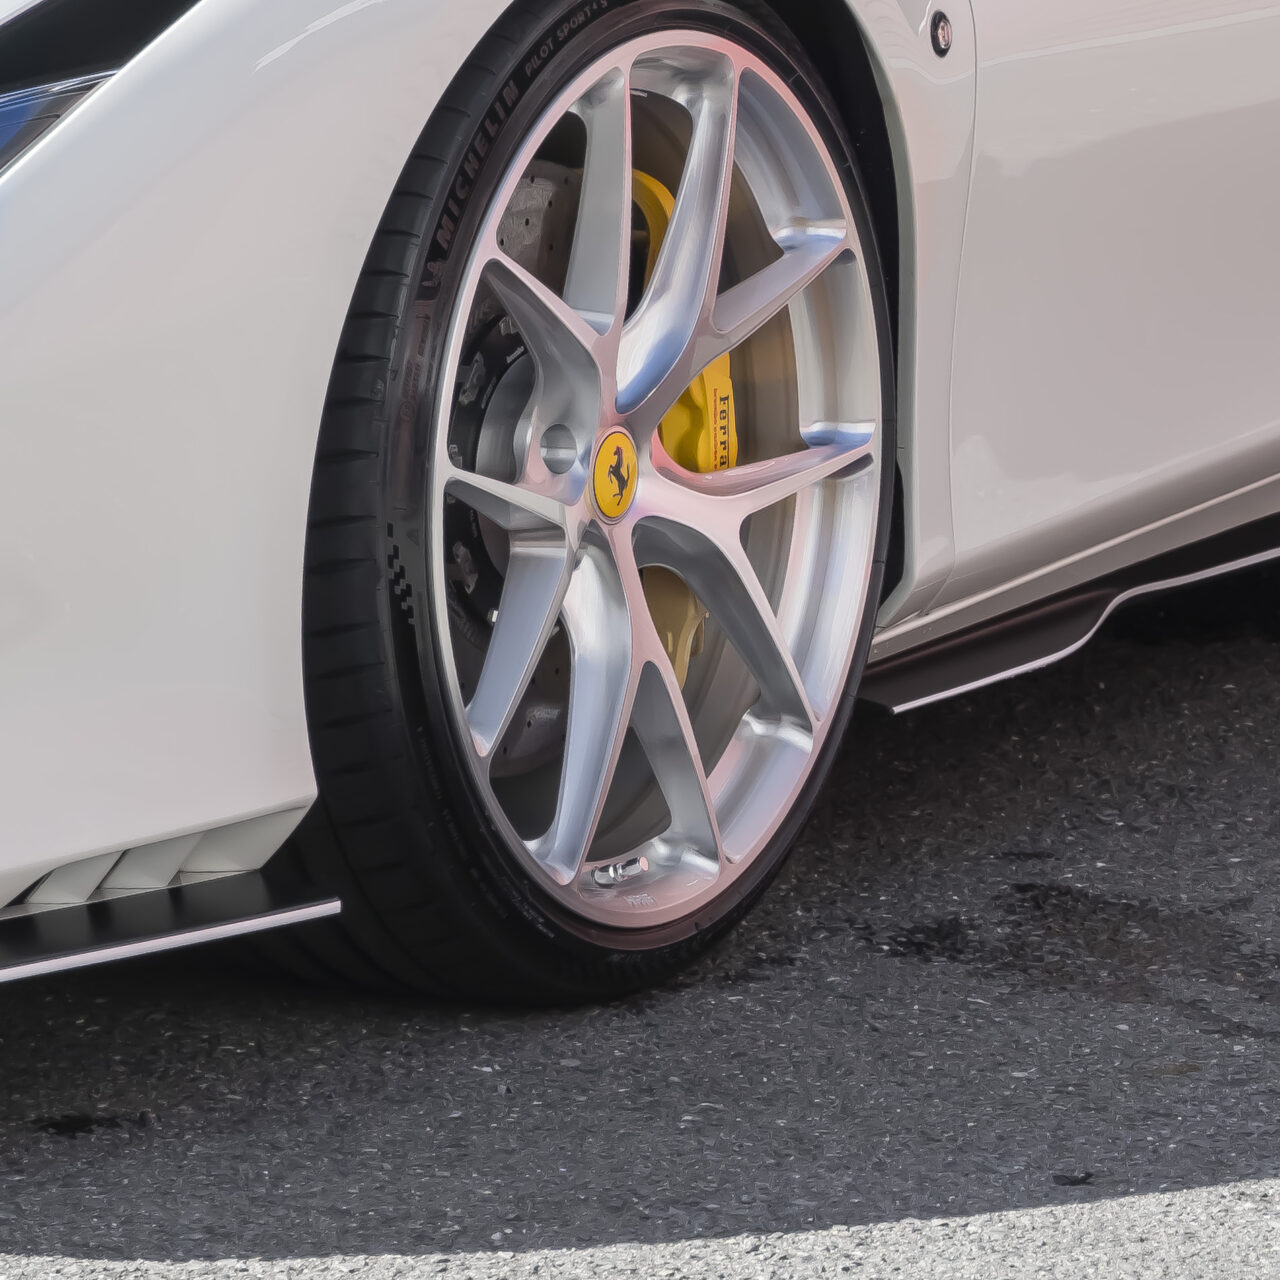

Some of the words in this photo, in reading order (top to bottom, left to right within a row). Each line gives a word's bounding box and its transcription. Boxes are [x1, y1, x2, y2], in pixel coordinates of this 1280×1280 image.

[436, 80, 520, 248] MICHELIN
[525, 40, 556, 77] PILOT
[557, 8, 592, 40] SPORT
[720, 394, 730, 467] Ferra
